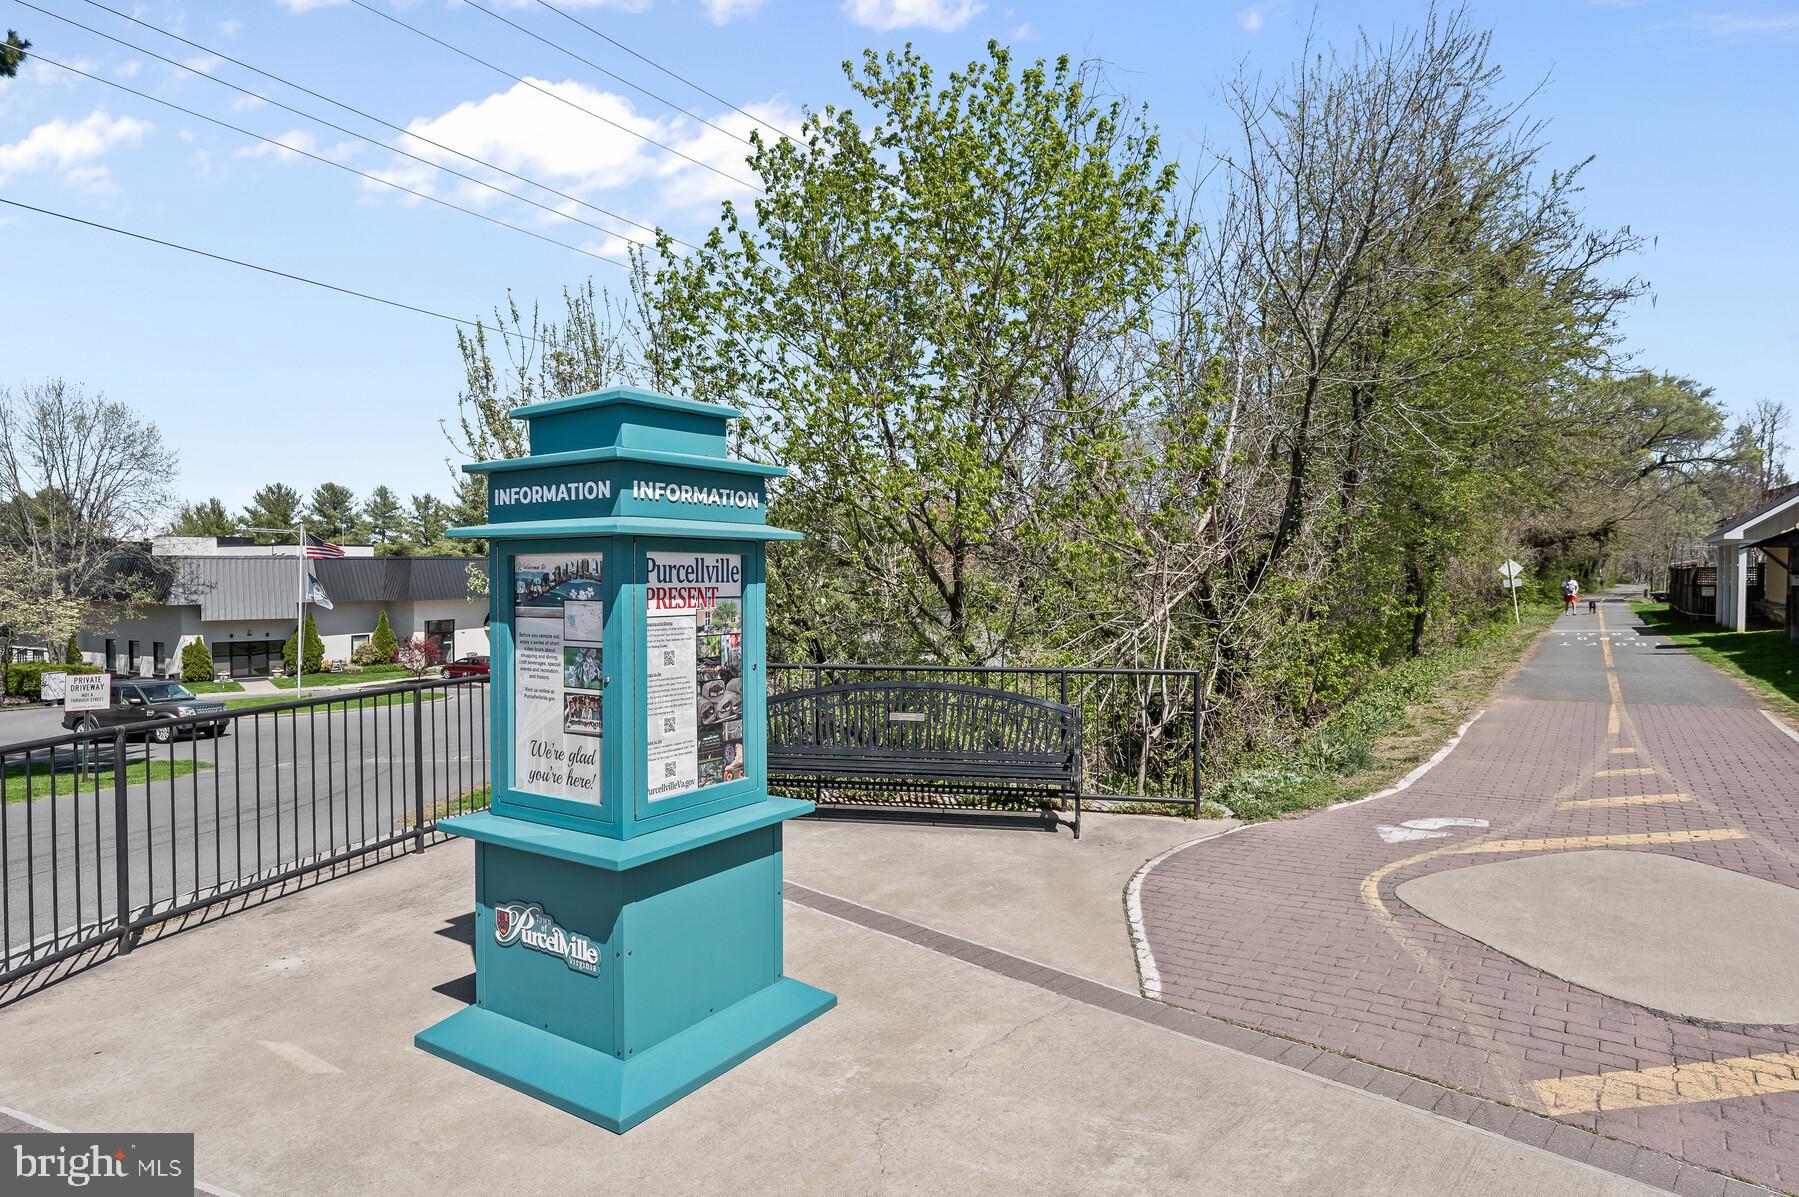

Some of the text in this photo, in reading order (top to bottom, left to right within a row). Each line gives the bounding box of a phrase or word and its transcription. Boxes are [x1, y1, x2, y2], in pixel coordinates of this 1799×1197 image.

[494, 480, 611, 506] INFORMATION
[633, 480, 759, 508] INFORMATION
[646, 558, 740, 584] Purcellville
[646, 586, 718, 610] PRESENT
[70, 684, 104, 692] DRIVEWAY
[74, 676, 102, 684] PRIVATE
[531, 740, 596, 767] We're glad
[529, 766, 596, 789] you're here!
[648, 779, 696, 796] urcellvilleVa.gov
[536, 914, 552, 926] Town
[568, 956, 596, 972] Virginia
